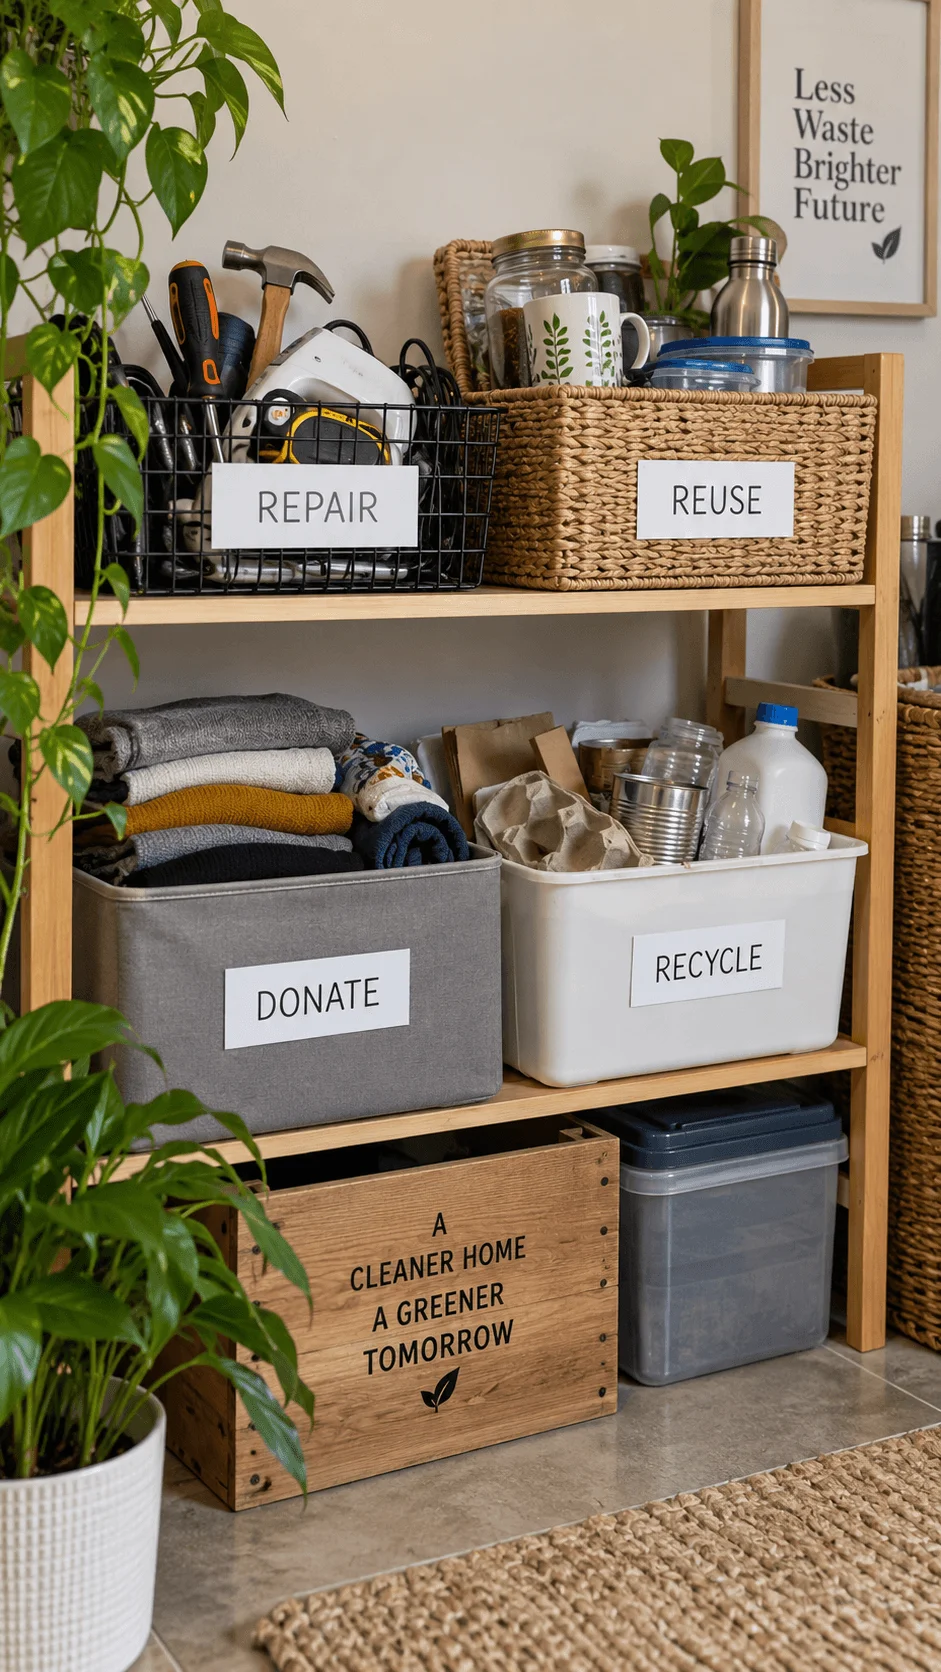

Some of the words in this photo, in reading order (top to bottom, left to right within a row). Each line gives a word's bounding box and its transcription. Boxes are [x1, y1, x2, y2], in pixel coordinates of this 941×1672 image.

[794, 67, 855, 104] Less
[793, 108, 874, 145] Waste
[794, 147, 902, 191] Brighter
[794, 187, 885, 224] Future
[258, 490, 379, 524] REPAIR
[673, 485, 762, 515] REUSE
[655, 943, 764, 984] RECYCLE
[257, 976, 381, 1021] DONATE
[431, 1212, 448, 1238] A
[350, 1249, 454, 1292] CLEANER
[462, 1235, 527, 1270] HOME
[372, 1306, 389, 1333] A
[396, 1282, 504, 1326] GREENER
[363, 1318, 514, 1375] TOMORROW
